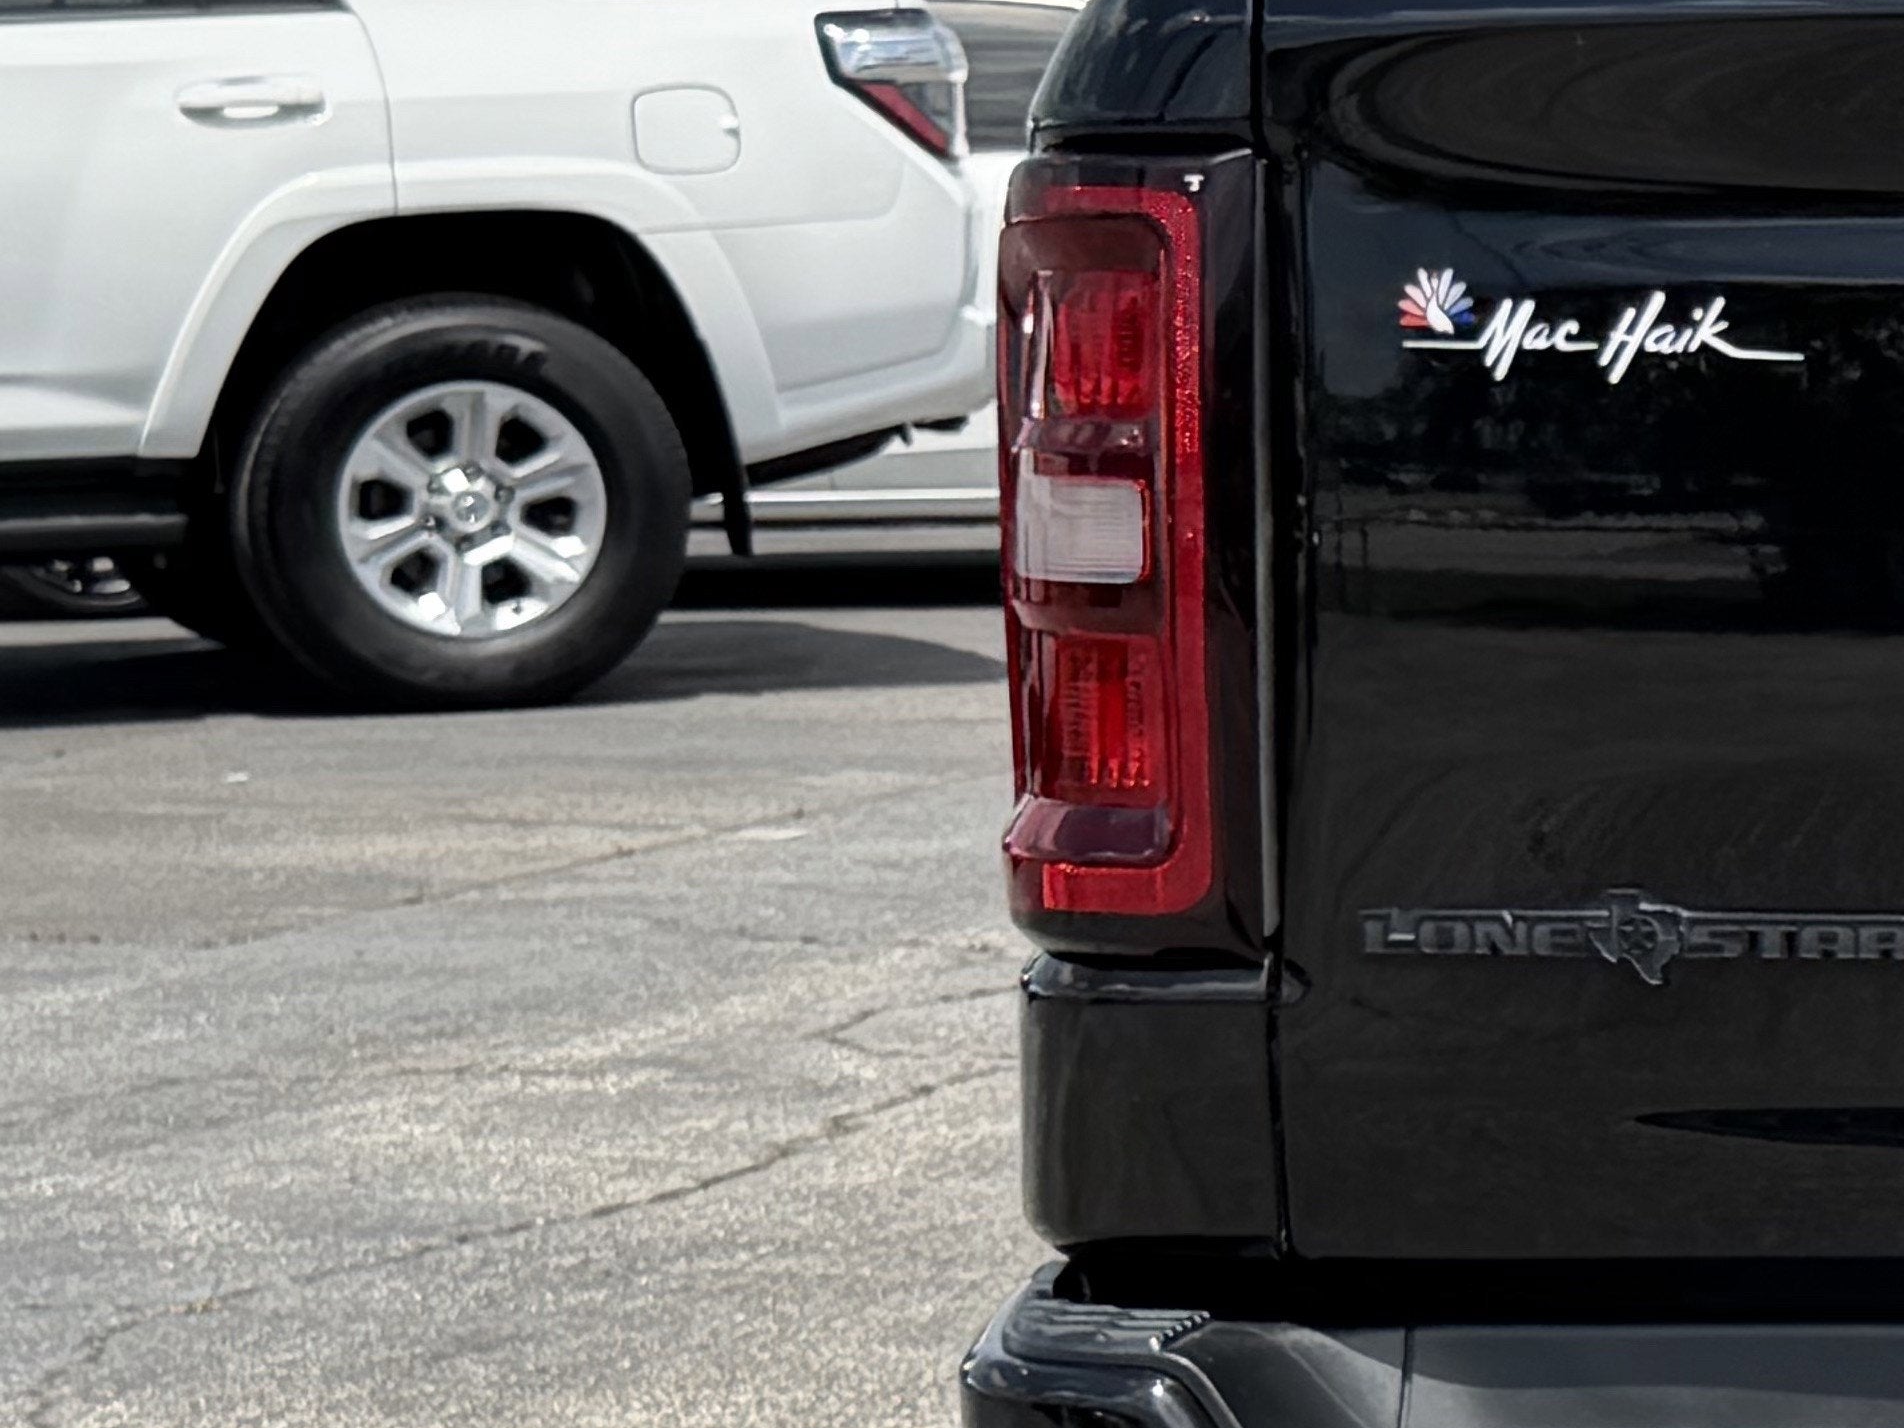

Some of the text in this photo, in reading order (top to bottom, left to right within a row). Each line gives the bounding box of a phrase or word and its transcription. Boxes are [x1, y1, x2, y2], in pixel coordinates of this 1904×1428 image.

[1475, 290, 1745, 385] Mac Haik
[1362, 910, 1590, 957] LONE
